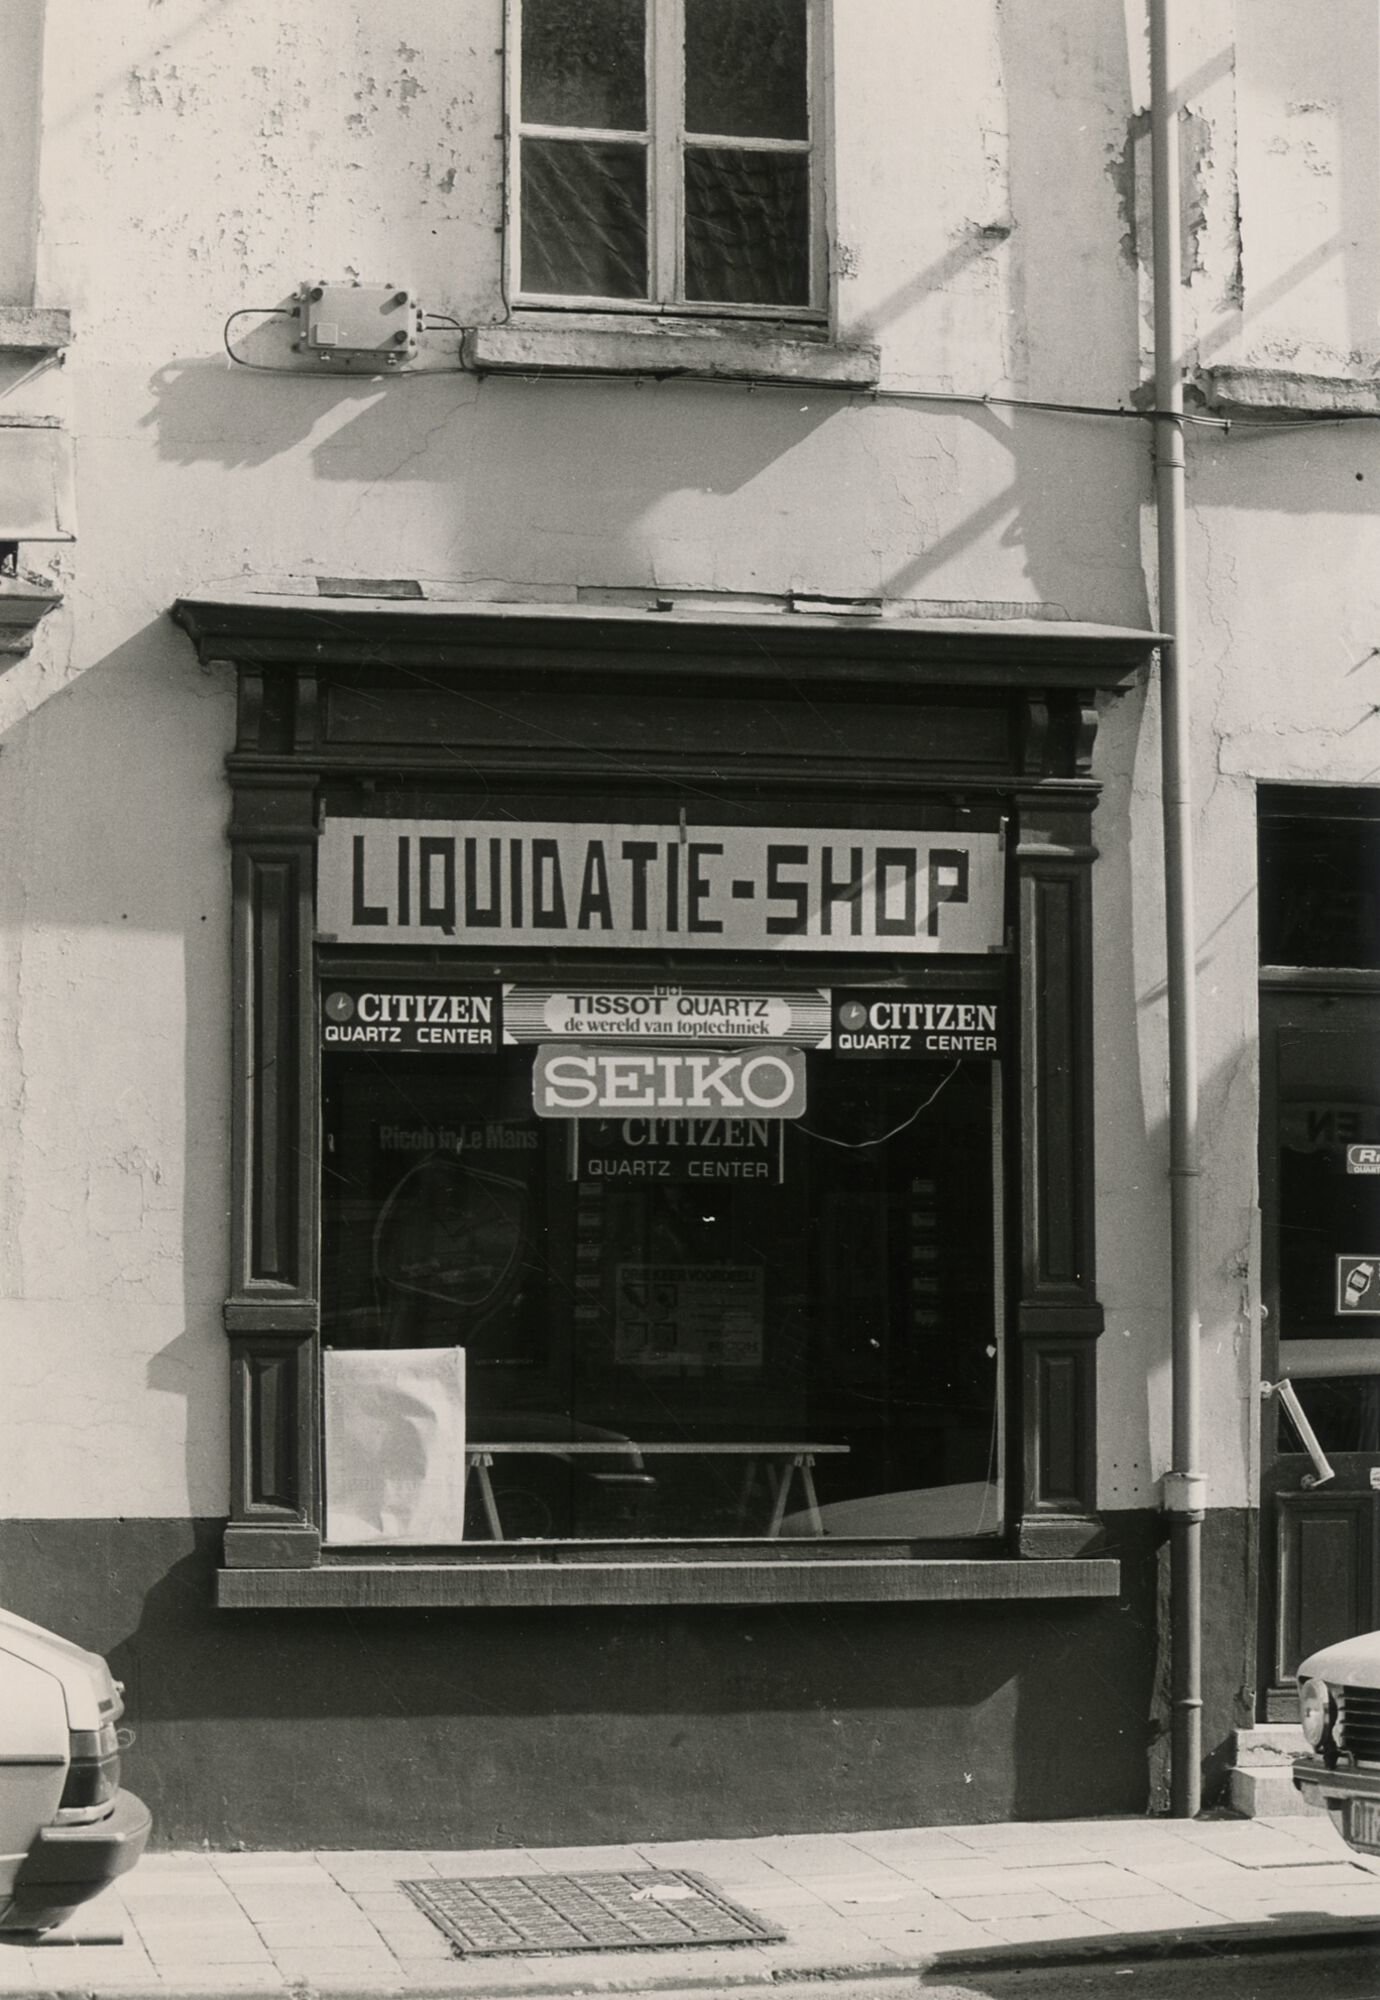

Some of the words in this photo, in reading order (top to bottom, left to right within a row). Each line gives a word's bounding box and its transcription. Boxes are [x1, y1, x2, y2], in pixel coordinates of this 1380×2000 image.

[352, 835, 969, 937] LIQUIDATIE-SHOP
[357, 993, 492, 1024] CITIZEN
[567, 995, 668, 1015] TISSOT
[676, 997, 769, 1017] QUARTZ
[869, 1002, 998, 1032] CITIZEN
[325, 1026, 401, 1043] QUARTZ
[417, 1027, 492, 1044] CENTER
[564, 1017, 584, 1032] de
[587, 1018, 640, 1033] wereld
[644, 1021, 673, 1033] van
[677, 1019, 770, 1037] toptechniek
[838, 1033, 912, 1050] QUARTZ
[926, 1035, 998, 1052] CENTER
[544, 1055, 795, 1108] SEIKO
[379, 1124, 434, 1150] Ricoh
[438, 1125, 456, 1150] in
[460, 1125, 483, 1150] Le
[485, 1125, 539, 1150] Mans
[621, 1118, 769, 1147] CITIZEN
[587, 1159, 671, 1177] QUARTZ
[688, 1160, 769, 1178] CENTER
